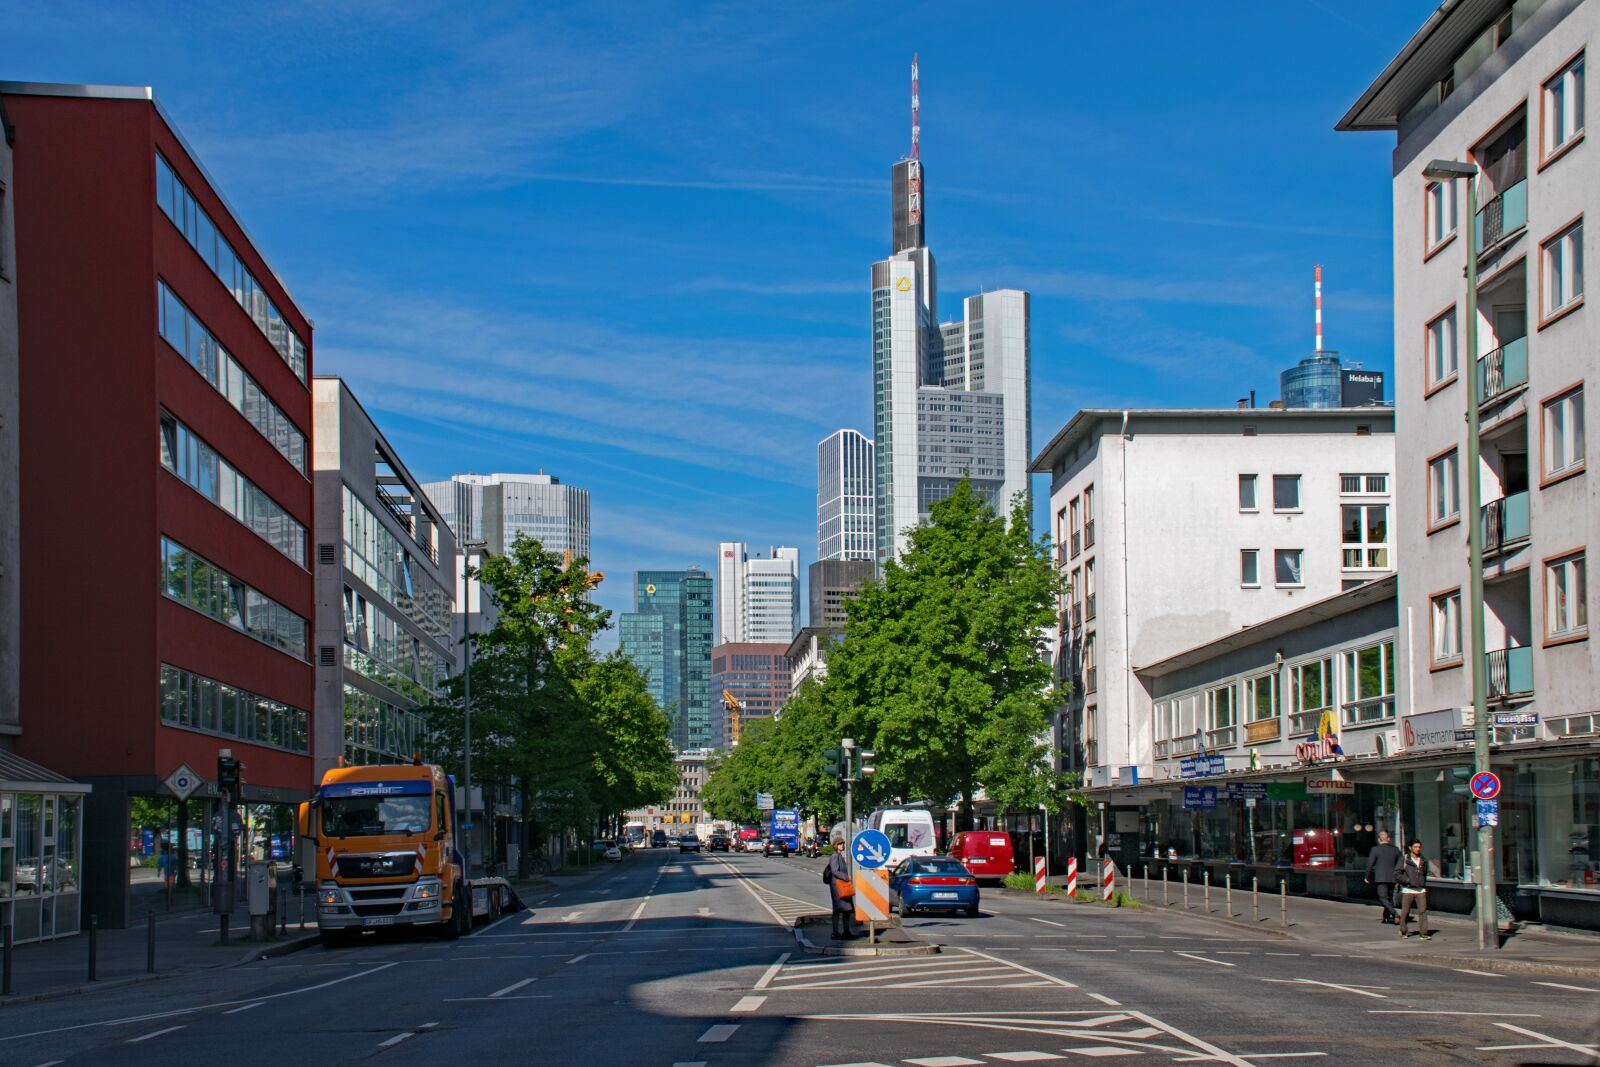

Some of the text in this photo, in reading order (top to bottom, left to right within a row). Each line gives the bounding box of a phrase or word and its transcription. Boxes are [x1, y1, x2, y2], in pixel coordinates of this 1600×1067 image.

[1349, 374, 1374, 383] Helaba
[1497, 714, 1537, 725] Hasengasse
[1416, 728, 1453, 746] berkemann
[360, 861, 393, 869] MAN
